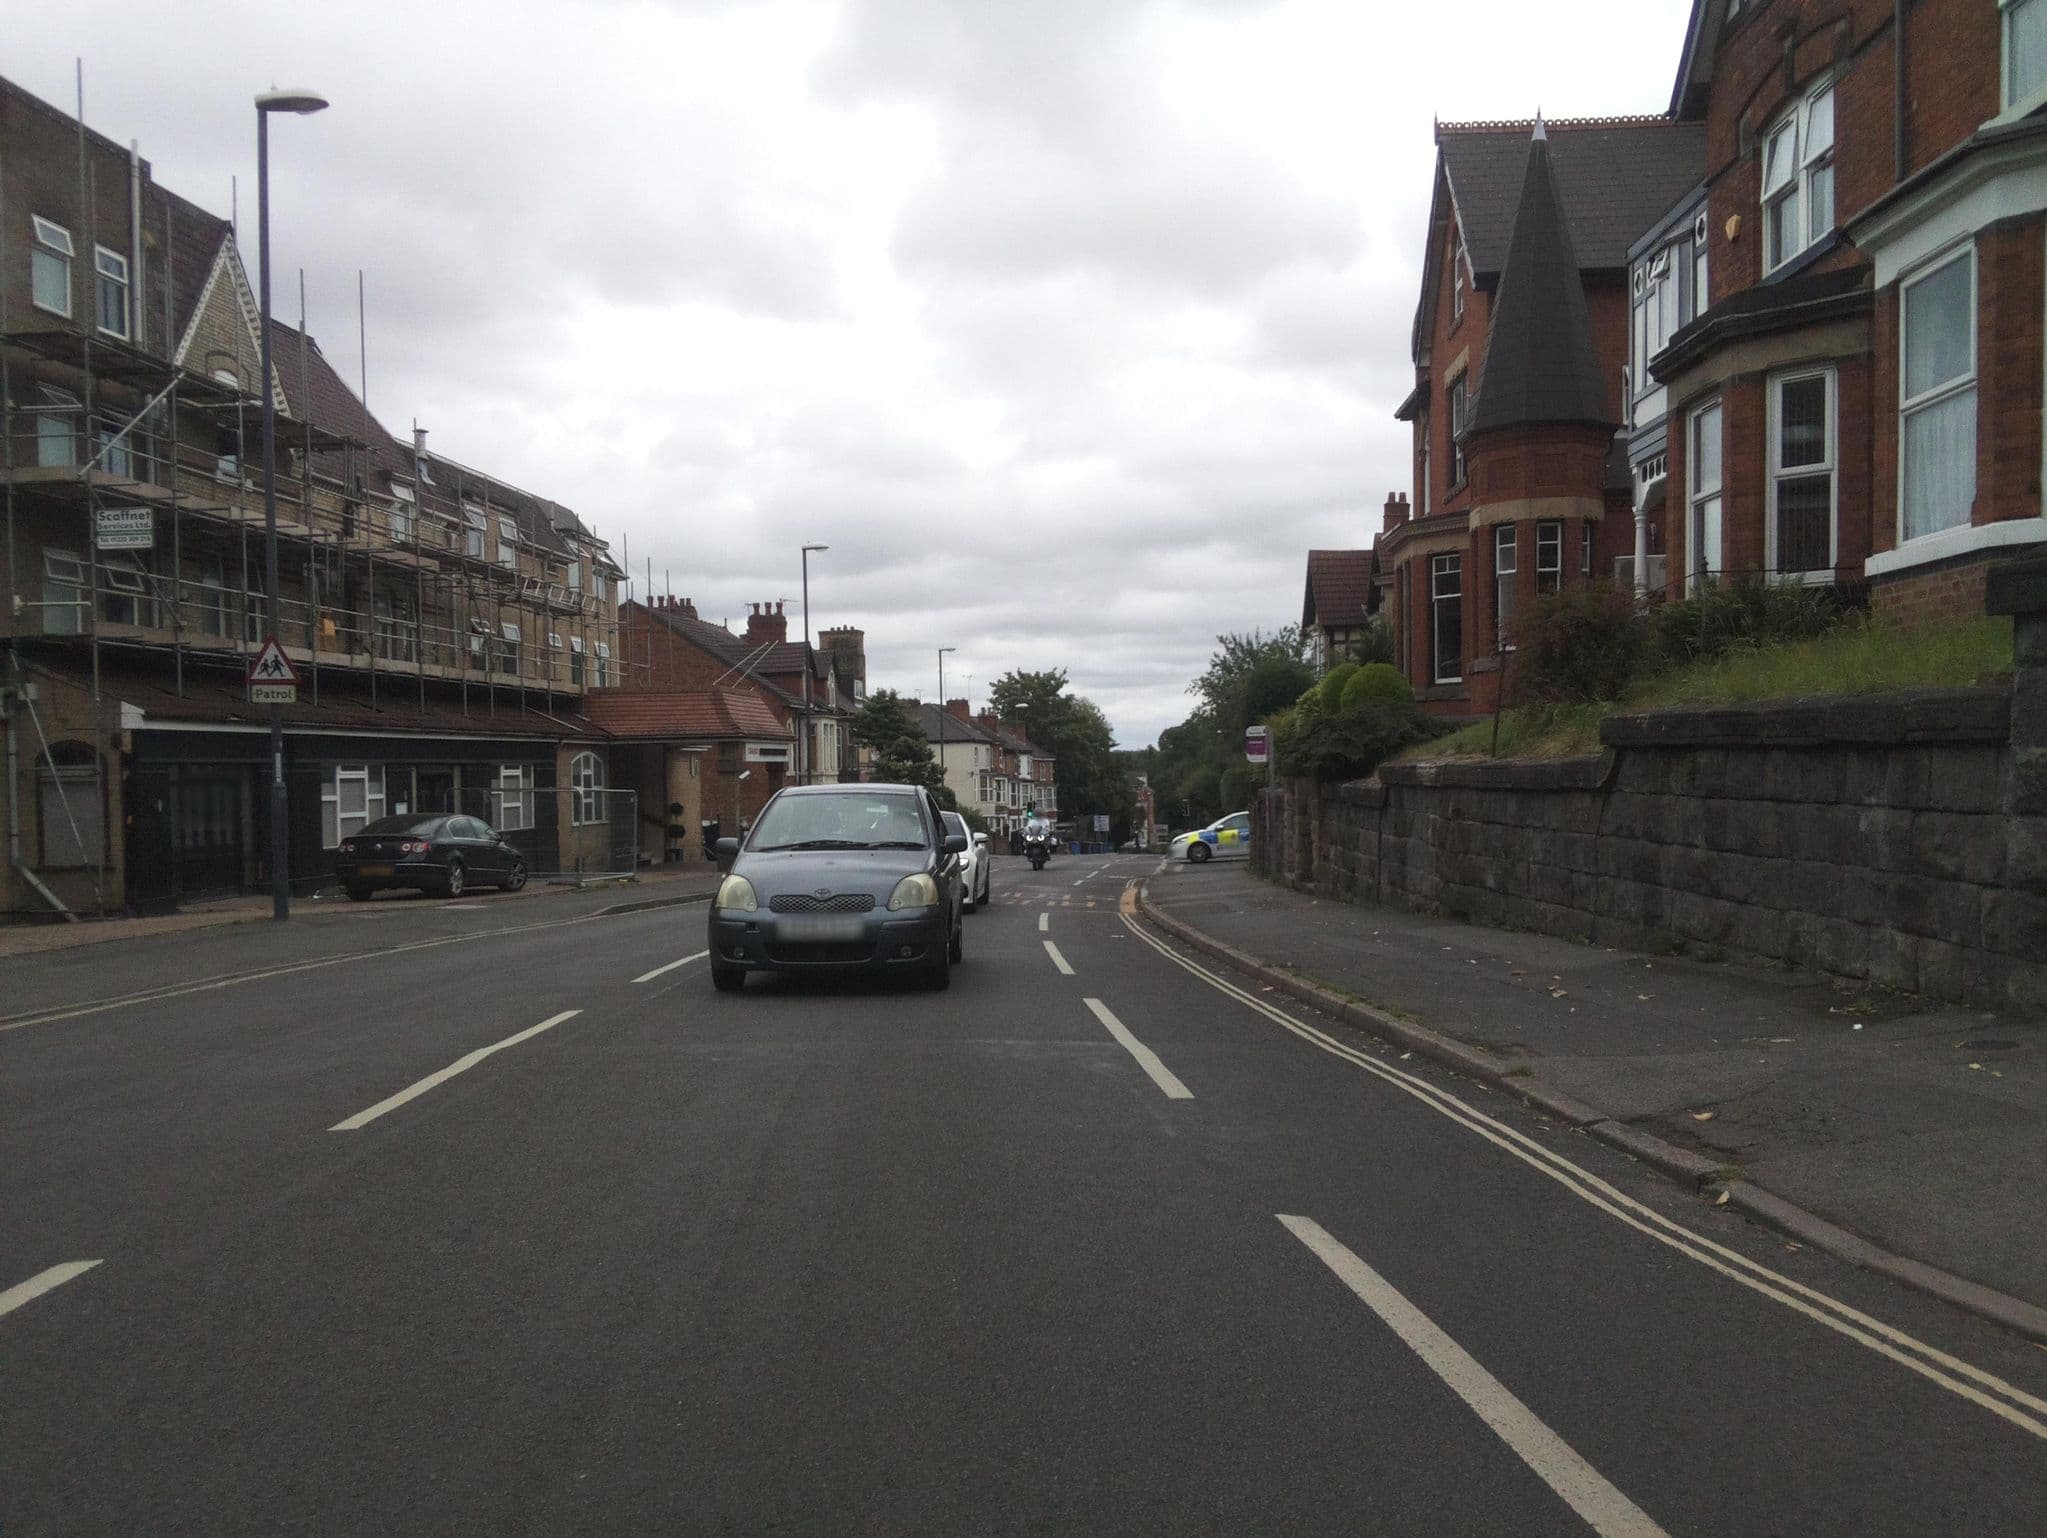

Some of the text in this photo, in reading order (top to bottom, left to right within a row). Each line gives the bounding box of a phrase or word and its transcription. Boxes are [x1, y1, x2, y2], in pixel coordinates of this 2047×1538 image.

[98, 510, 150, 521] Scaffnet
[98, 521, 133, 529] Services
[256, 689, 292, 699] Patrol
